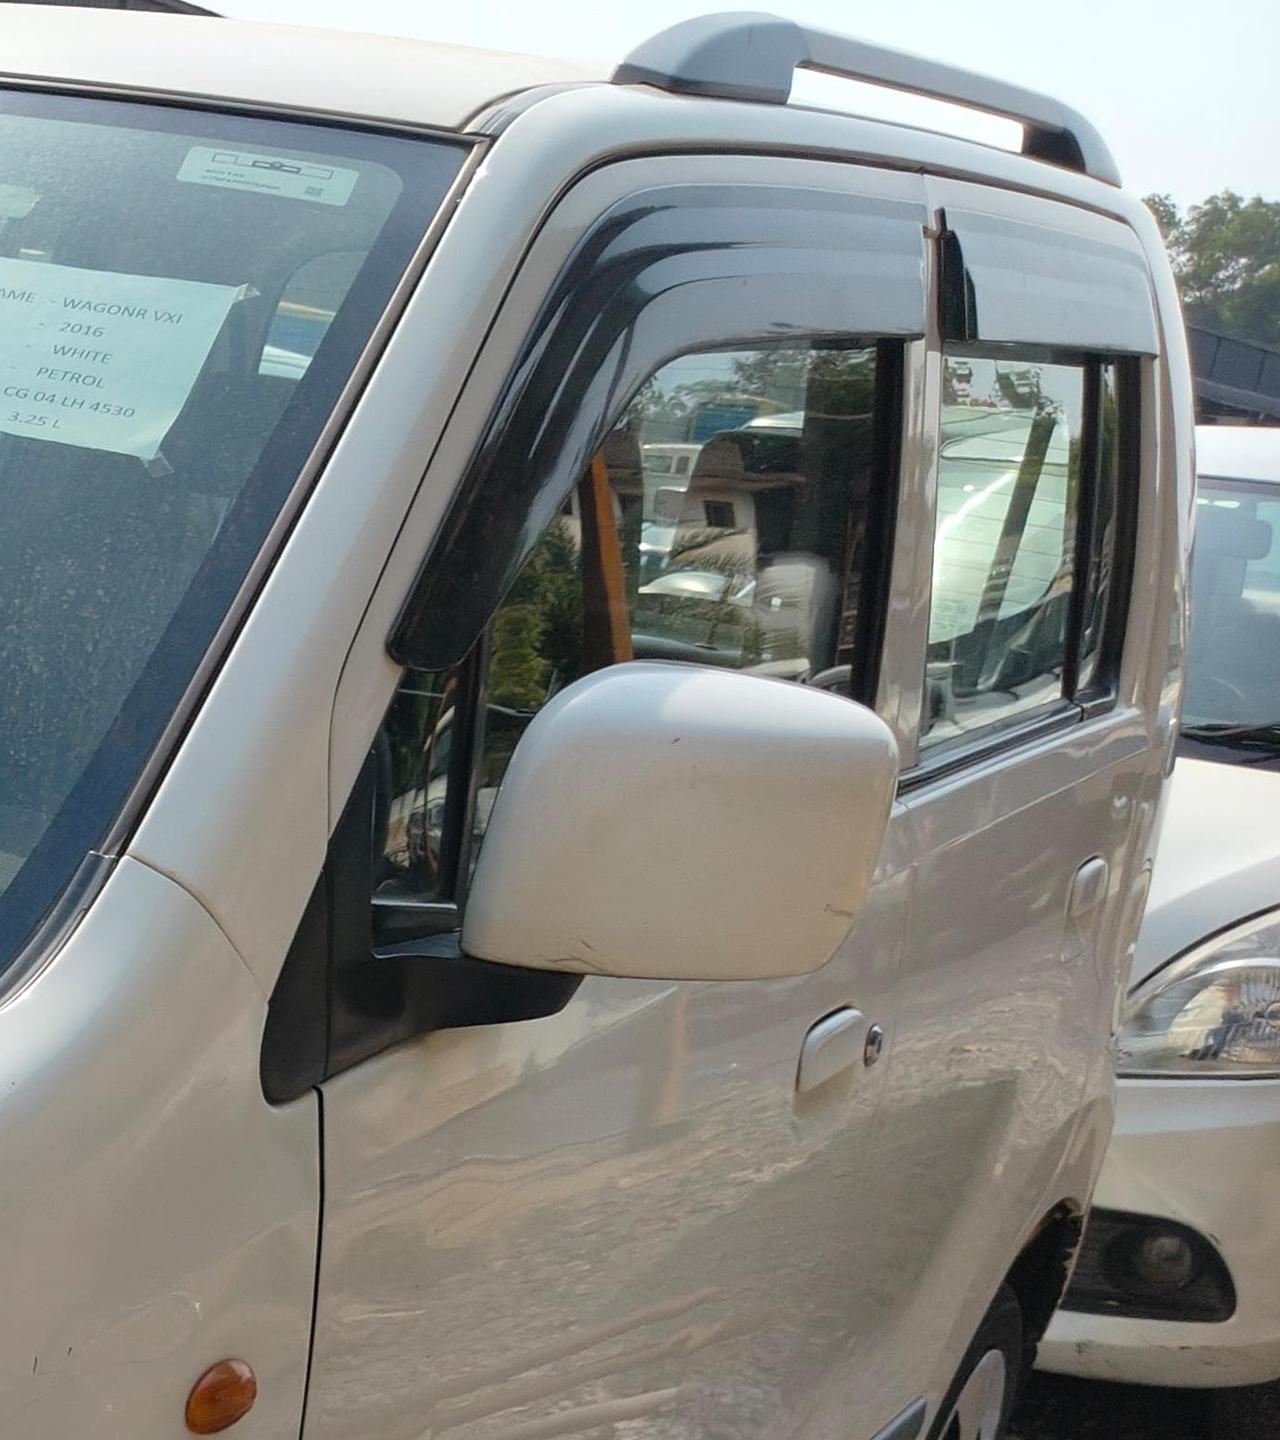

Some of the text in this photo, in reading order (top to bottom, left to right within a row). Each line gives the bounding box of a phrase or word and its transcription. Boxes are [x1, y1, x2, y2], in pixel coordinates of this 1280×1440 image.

[62, 297, 148, 320] WAGONR
[153, 310, 184, 325] VXI
[59, 321, 106, 338] 2016
[52, 344, 113, 365] WHITE
[36, 367, 106, 389] PETROL
[3, 385, 29, 400] CG
[32, 390, 57, 405] 04
[60, 396, 85, 410] LH
[89, 402, 136, 419] 4530
[7, 411, 47, 427] 3.25
[52, 419, 61, 430] L
